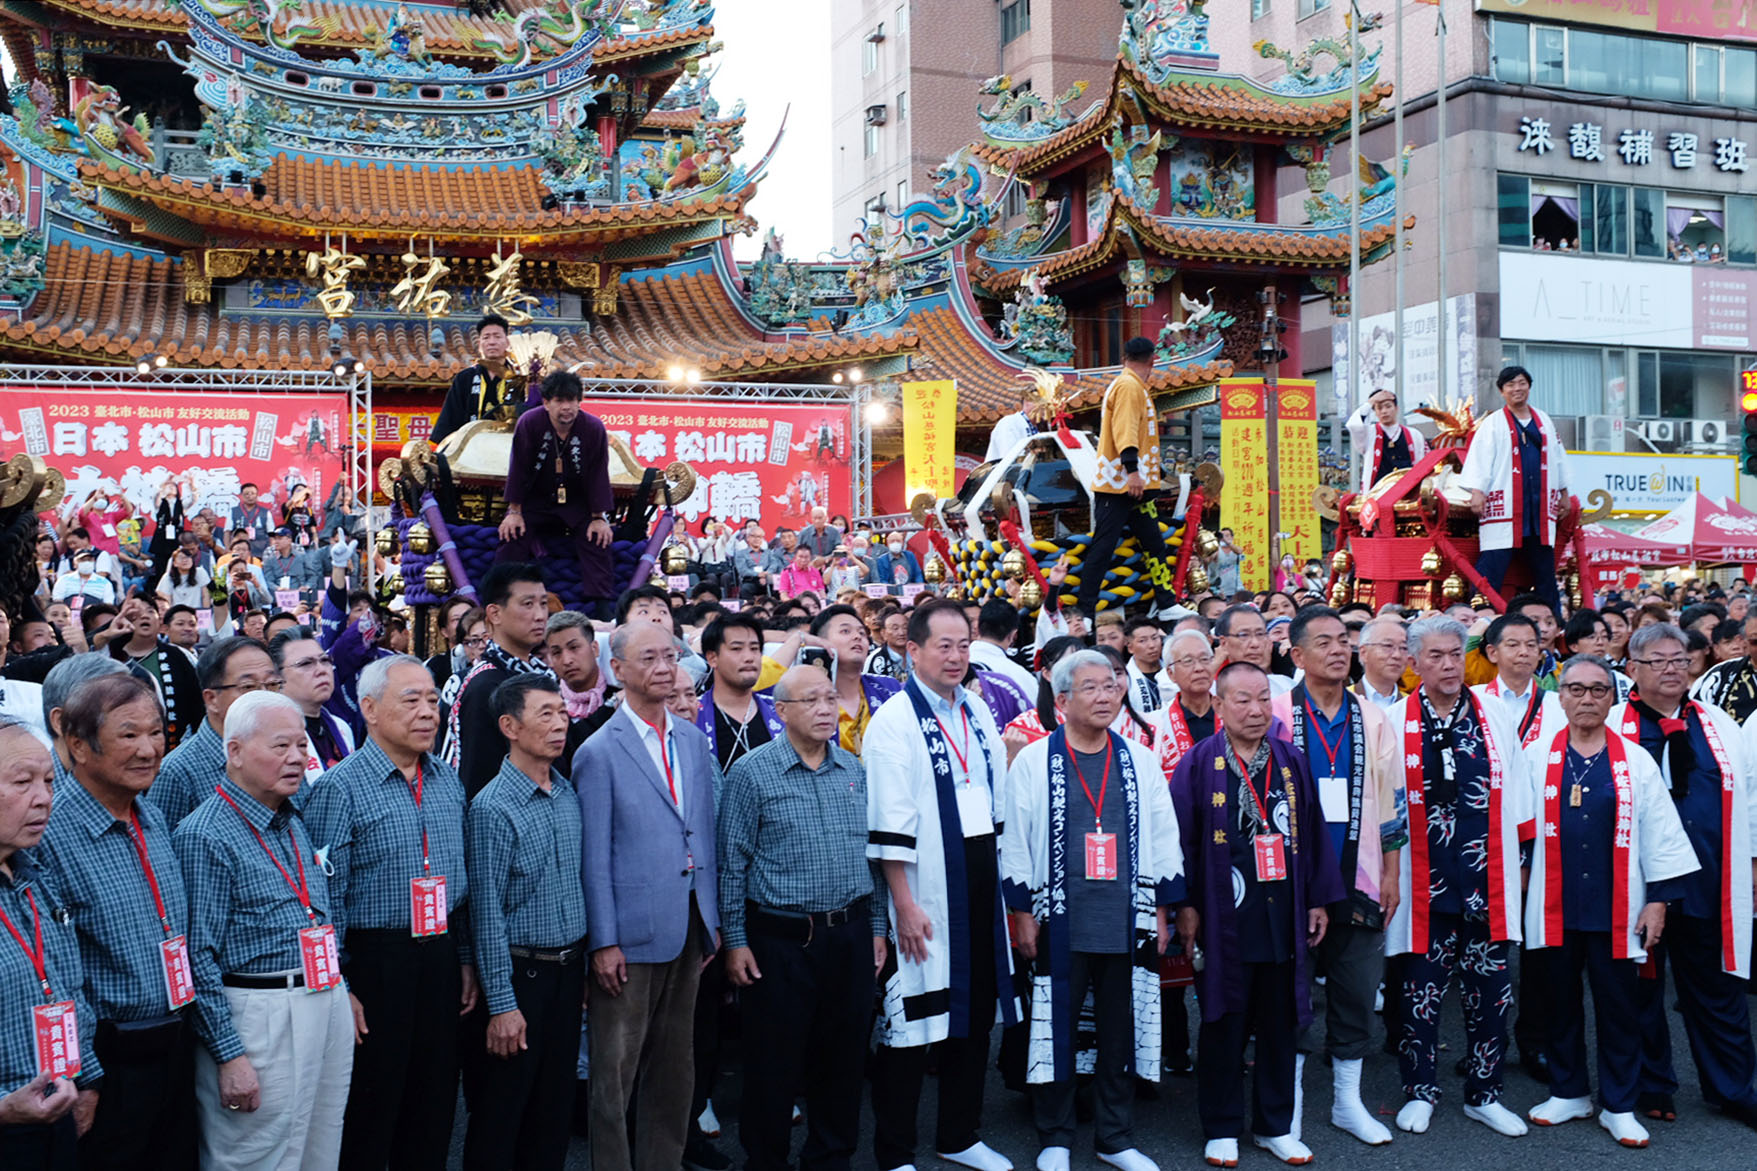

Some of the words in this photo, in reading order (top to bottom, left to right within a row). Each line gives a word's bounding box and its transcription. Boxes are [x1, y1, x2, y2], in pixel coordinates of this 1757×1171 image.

[49, 405, 90, 417] 2023
[600, 414, 634, 426] 2023
[53, 421, 130, 457] 日本
[138, 422, 248, 459] 松山市
[674, 430, 767, 464] 松山市
[921, 717, 950, 776] 松山市
